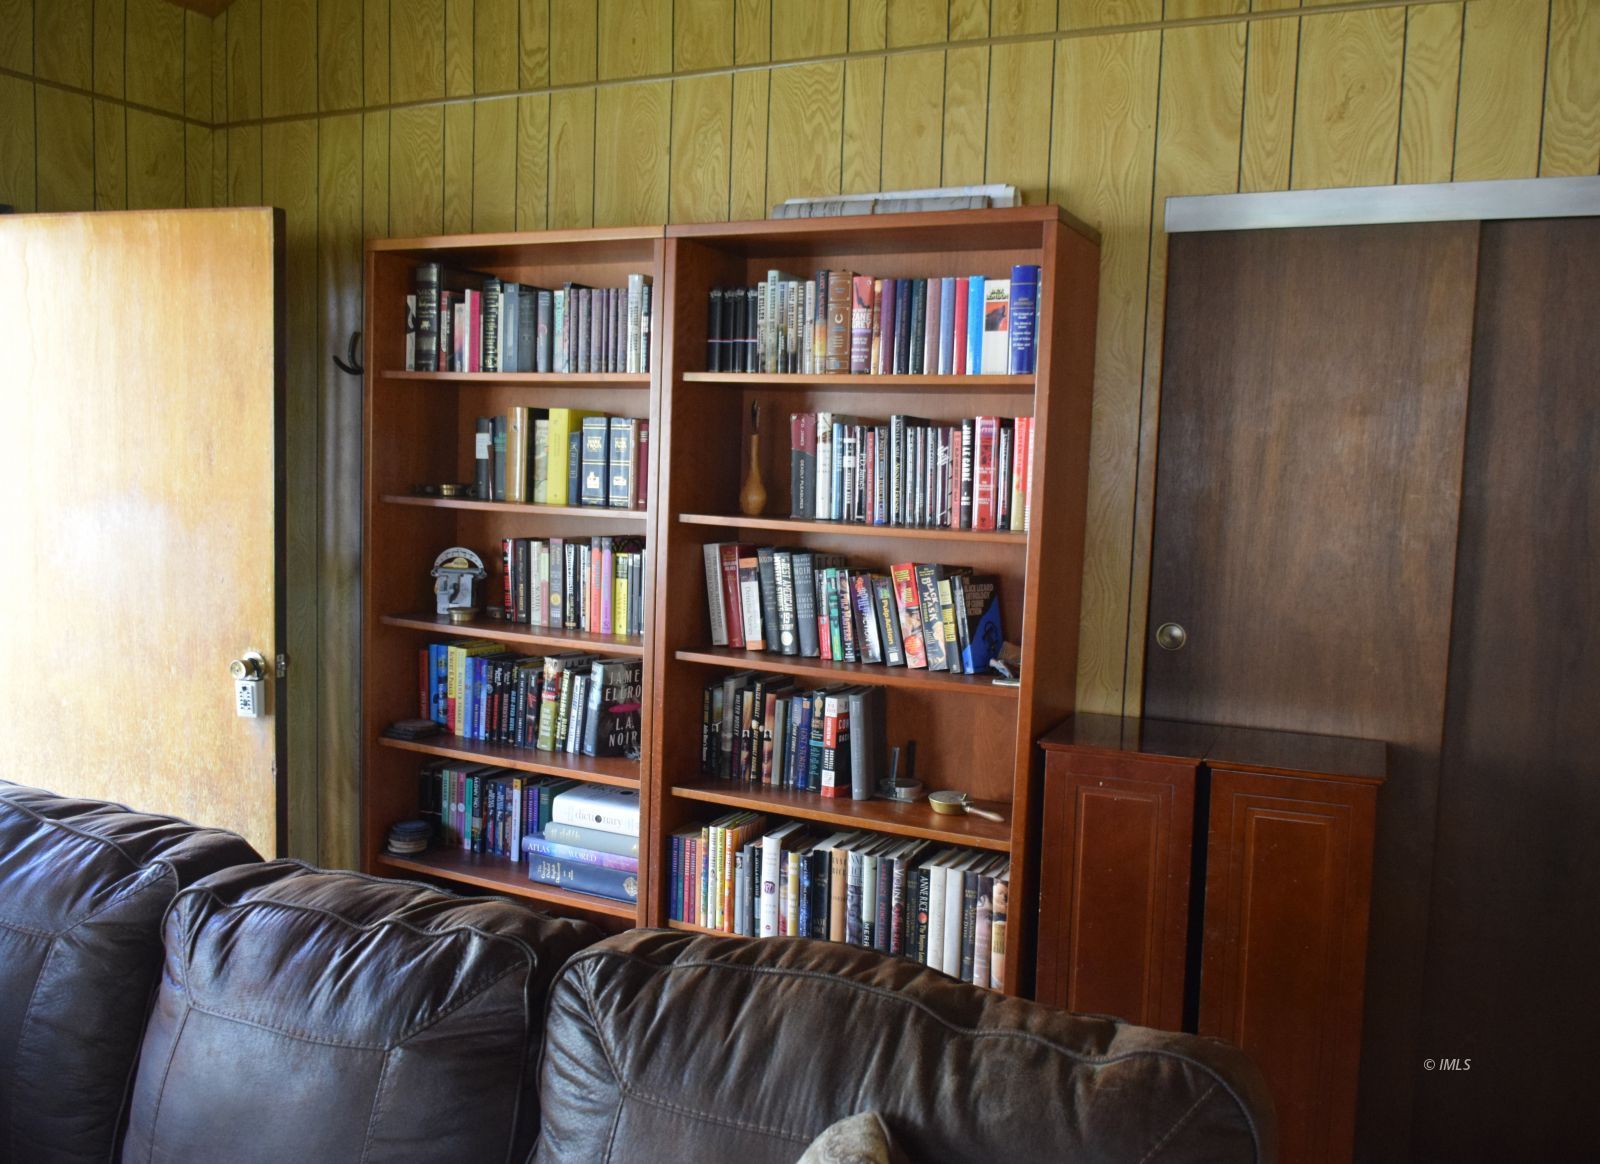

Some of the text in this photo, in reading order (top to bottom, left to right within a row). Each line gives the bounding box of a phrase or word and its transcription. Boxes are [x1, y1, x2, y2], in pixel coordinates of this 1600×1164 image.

[782, 580, 793, 612] AMERICAN
[976, 583, 994, 592] LIZARD
[921, 577, 938, 622] BLACK MASK
[841, 610, 853, 641] MASTERS
[608, 668, 641, 686] JAME
[605, 684, 642, 702] ELLRO
[608, 731, 638, 748] NOIR
[798, 727, 808, 771] LOST STORIES
[527, 843, 597, 862] ATLAS WORLD
[893, 868, 904, 899] VIOLIN
[919, 875, 929, 896] ANNE
[919, 896, 928, 912] RICE
